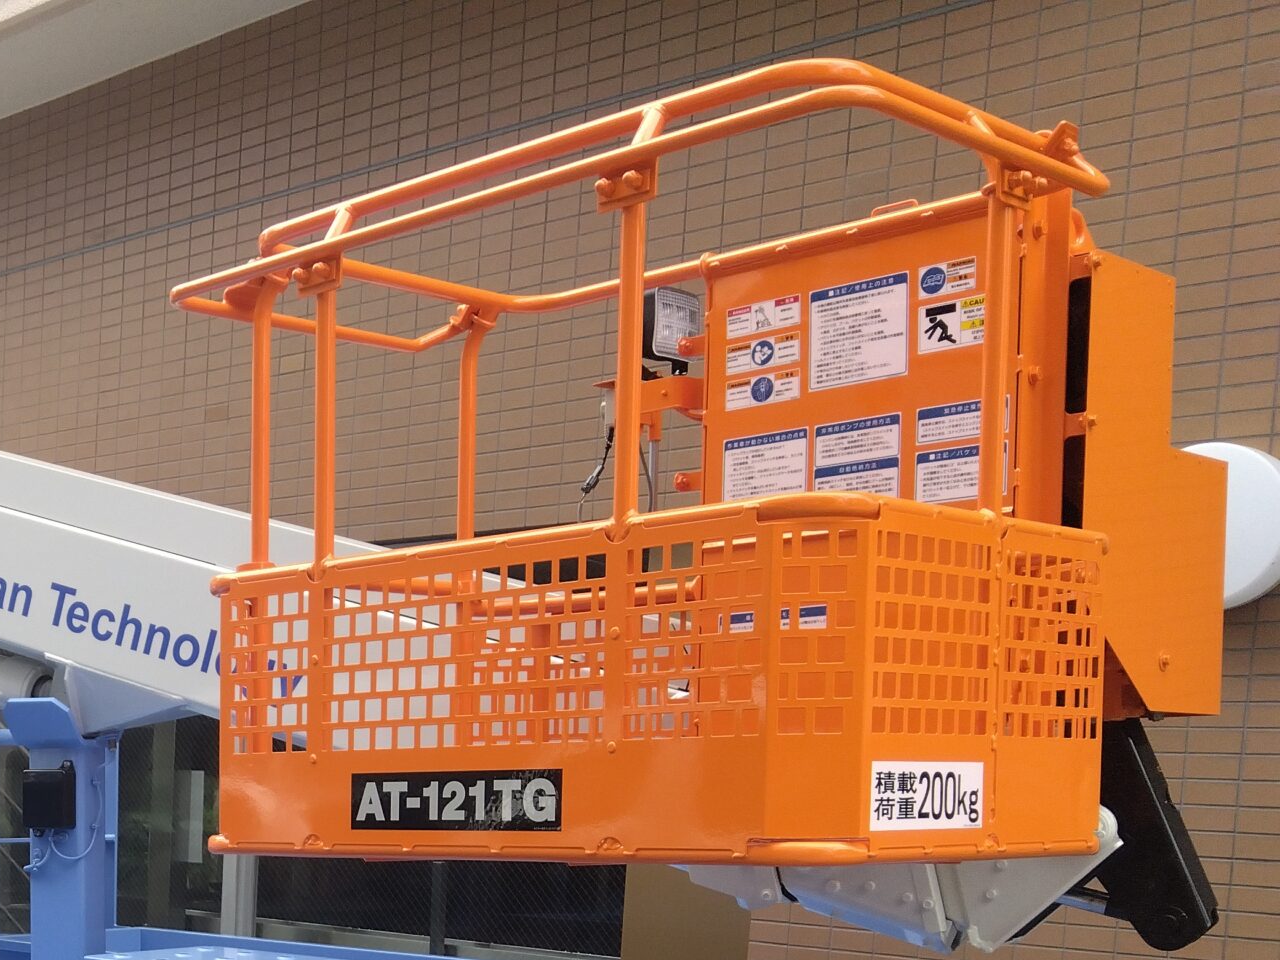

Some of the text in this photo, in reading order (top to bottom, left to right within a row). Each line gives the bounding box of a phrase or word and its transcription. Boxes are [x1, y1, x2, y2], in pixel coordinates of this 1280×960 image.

[875, 771, 917, 794] 積載
[918, 771, 979, 823] 200kg
[355, 778, 556, 823] AT-121TG
[874, 797, 916, 820] 荷重
